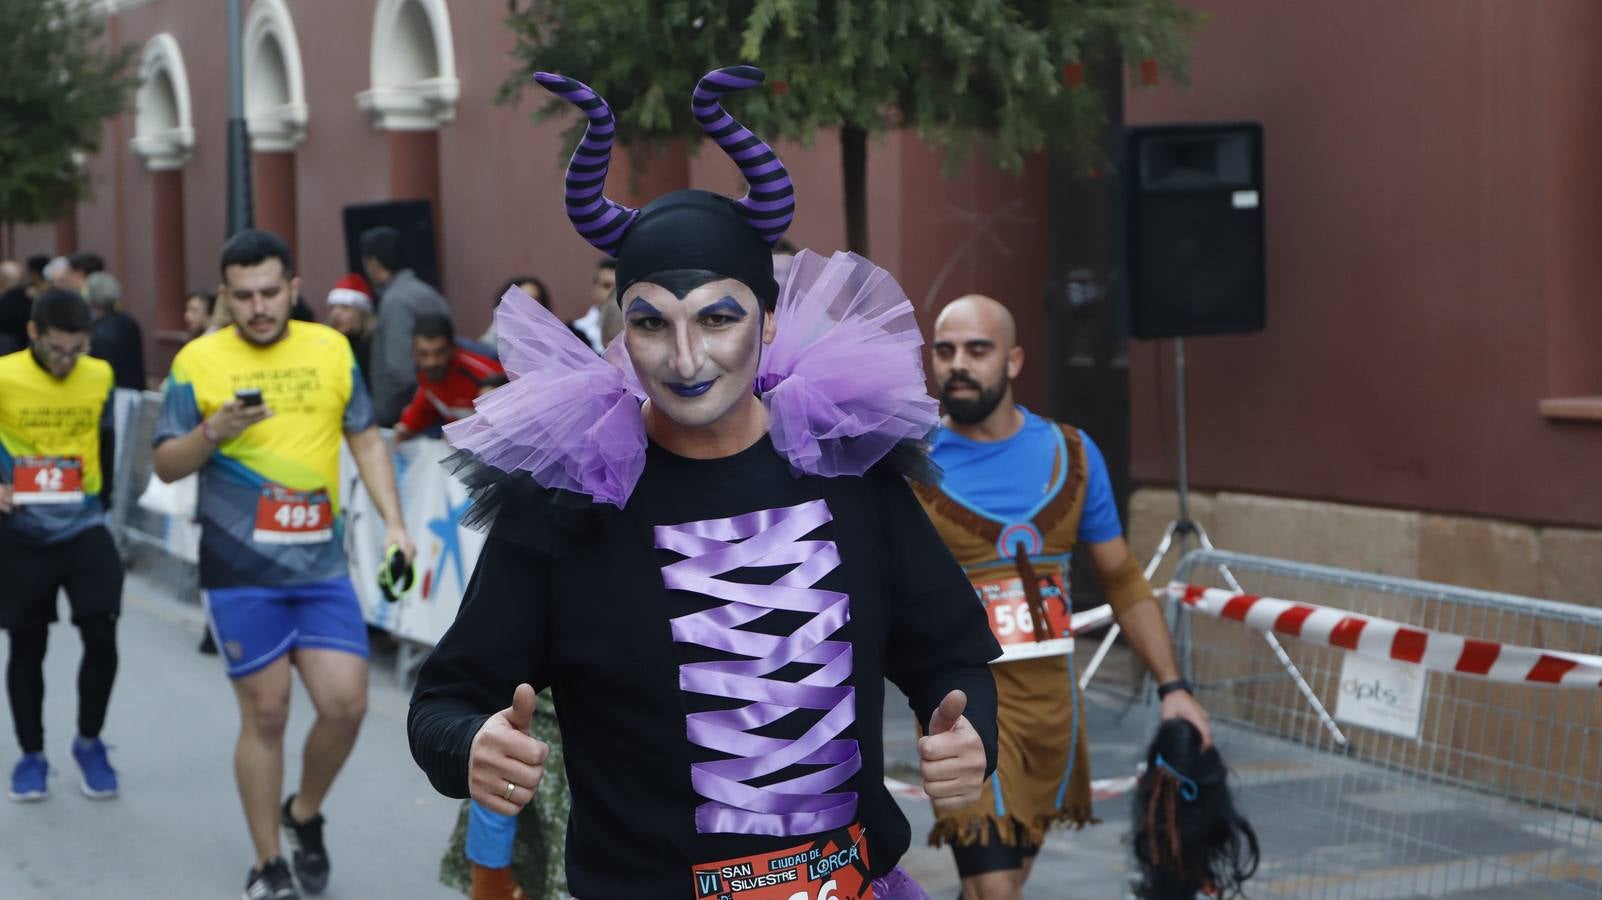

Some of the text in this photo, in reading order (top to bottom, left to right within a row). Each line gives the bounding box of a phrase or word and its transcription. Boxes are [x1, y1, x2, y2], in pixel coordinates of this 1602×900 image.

[34, 467, 63, 490] 42
[274, 503, 321, 528] 495
[771, 848, 821, 870] CIUDAD DE
[809, 846, 859, 880] LORCA
[722, 864, 751, 878] SAN
[731, 870, 797, 891] SILVESTRE
[699, 874, 718, 894] VI
